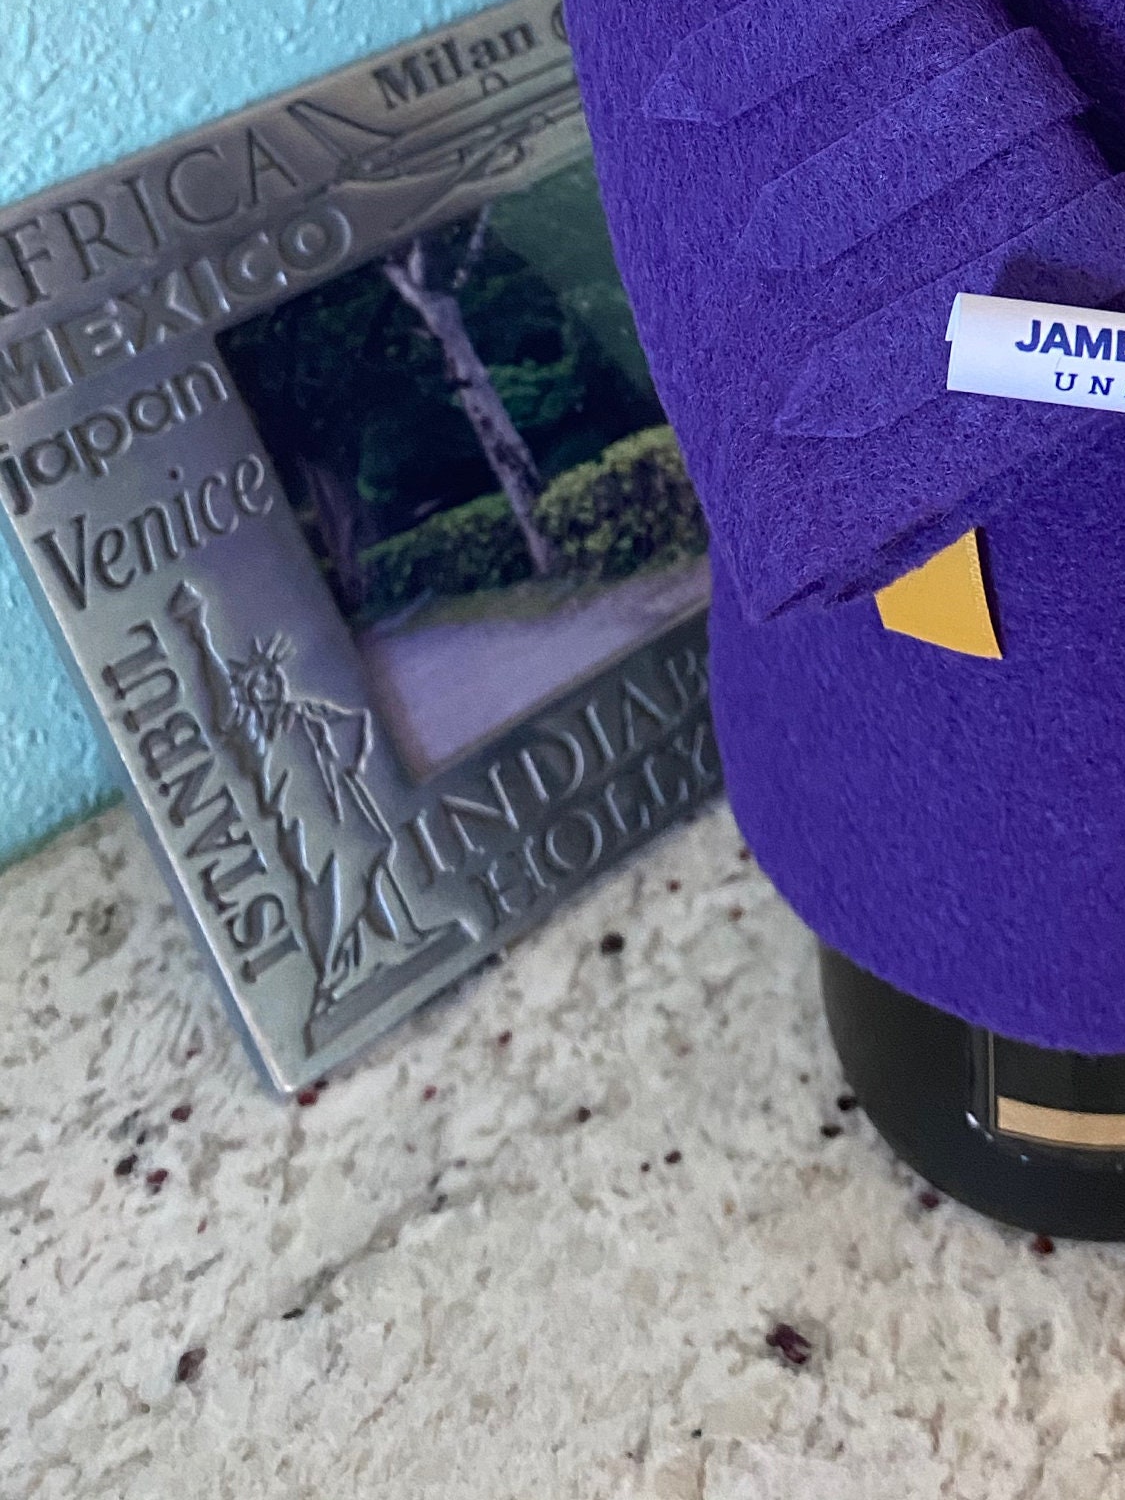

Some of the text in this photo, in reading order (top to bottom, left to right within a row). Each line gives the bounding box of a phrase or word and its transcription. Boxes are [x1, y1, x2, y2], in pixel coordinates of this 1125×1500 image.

[371, 21, 537, 110] Milan
[0, 125, 299, 316] FRICA
[0, 204, 352, 415] MEXICO
[0, 361, 228, 516] japan
[34, 453, 274, 611] Venice
[101, 619, 301, 984] ISTANBUL
